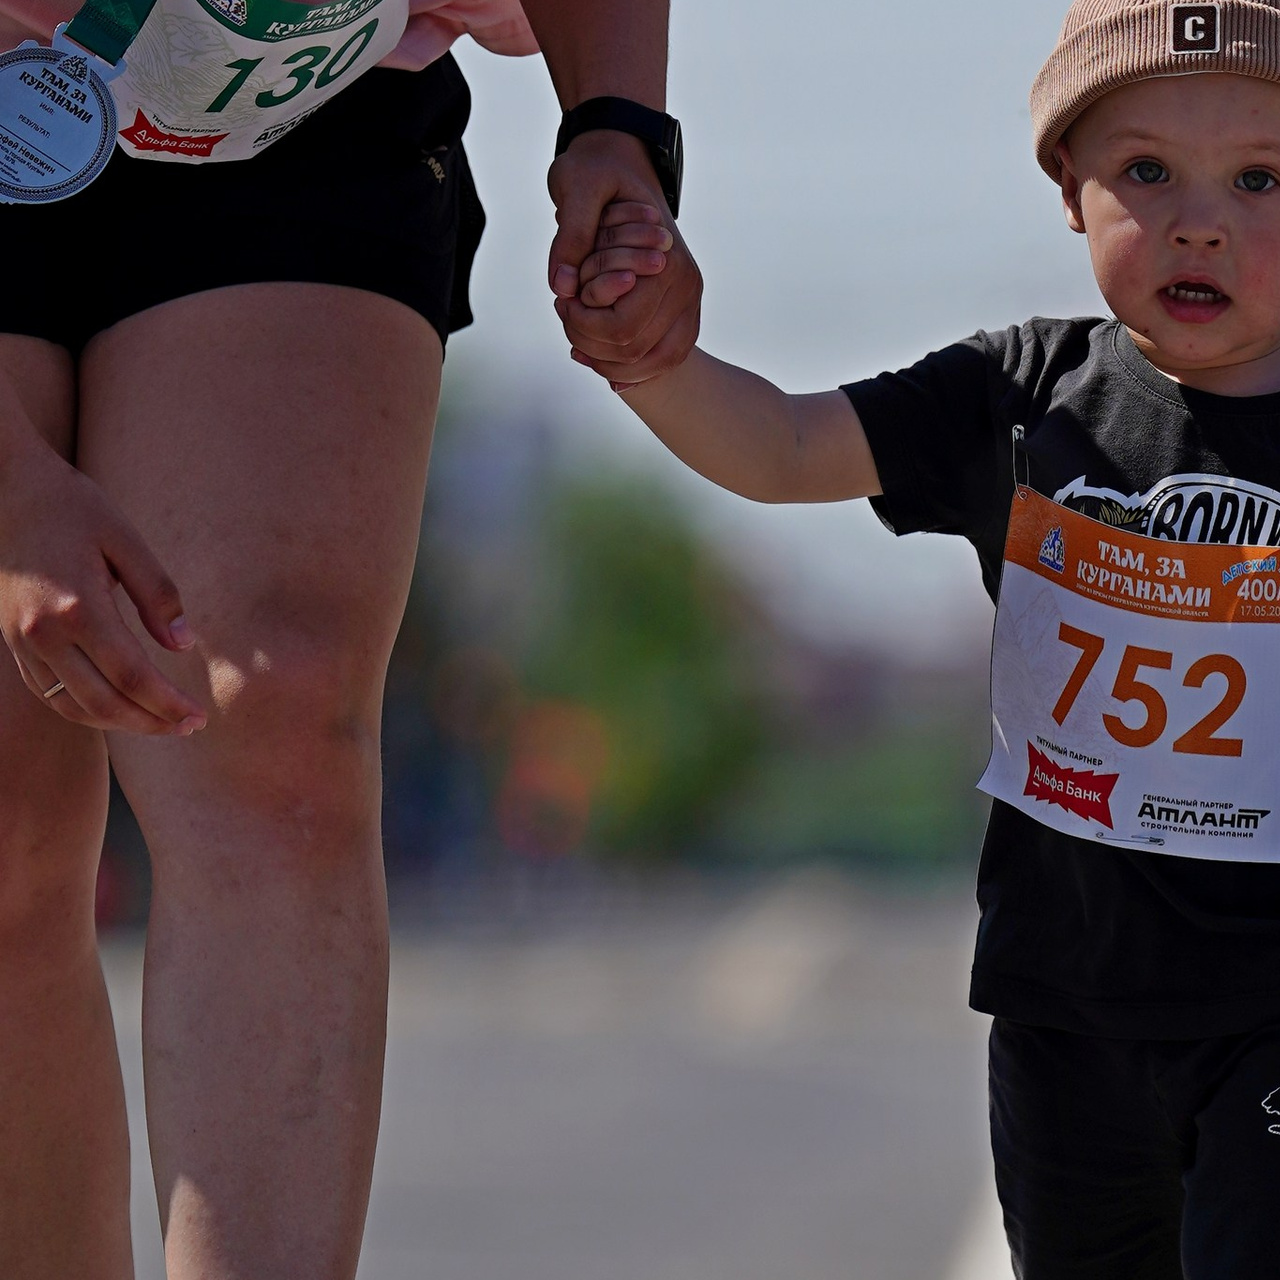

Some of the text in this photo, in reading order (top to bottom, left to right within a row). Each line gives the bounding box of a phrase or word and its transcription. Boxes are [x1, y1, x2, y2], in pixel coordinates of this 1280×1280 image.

[1185, 16, 1205, 40] C
[205, 18, 379, 113] 130
[19, 71, 94, 124] КУРГАНАМИ
[41, 67, 69, 95] ТАМ,
[70, 88, 88, 105] ЗА
[133, 129, 210, 149] Альфа Банк
[1098, 540, 1150, 576] ТАМ,
[1155, 556, 1187, 579] ЗА
[1221, 556, 1277, 586] ДЕТСКИЙ
[1076, 559, 1212, 608] КУРГАНАМИ
[1050, 622, 1248, 758] 752
[1036, 735, 1103, 766] ТИТУЛЬНЫЙ ПАРТНЕР
[1033, 765, 1102, 803] Альфа Банк
[1143, 793, 1234, 809] ГЕНЕРАЛЬНЫЙ ПАРТНЕР
[1140, 821, 1254, 838] строительная компания
